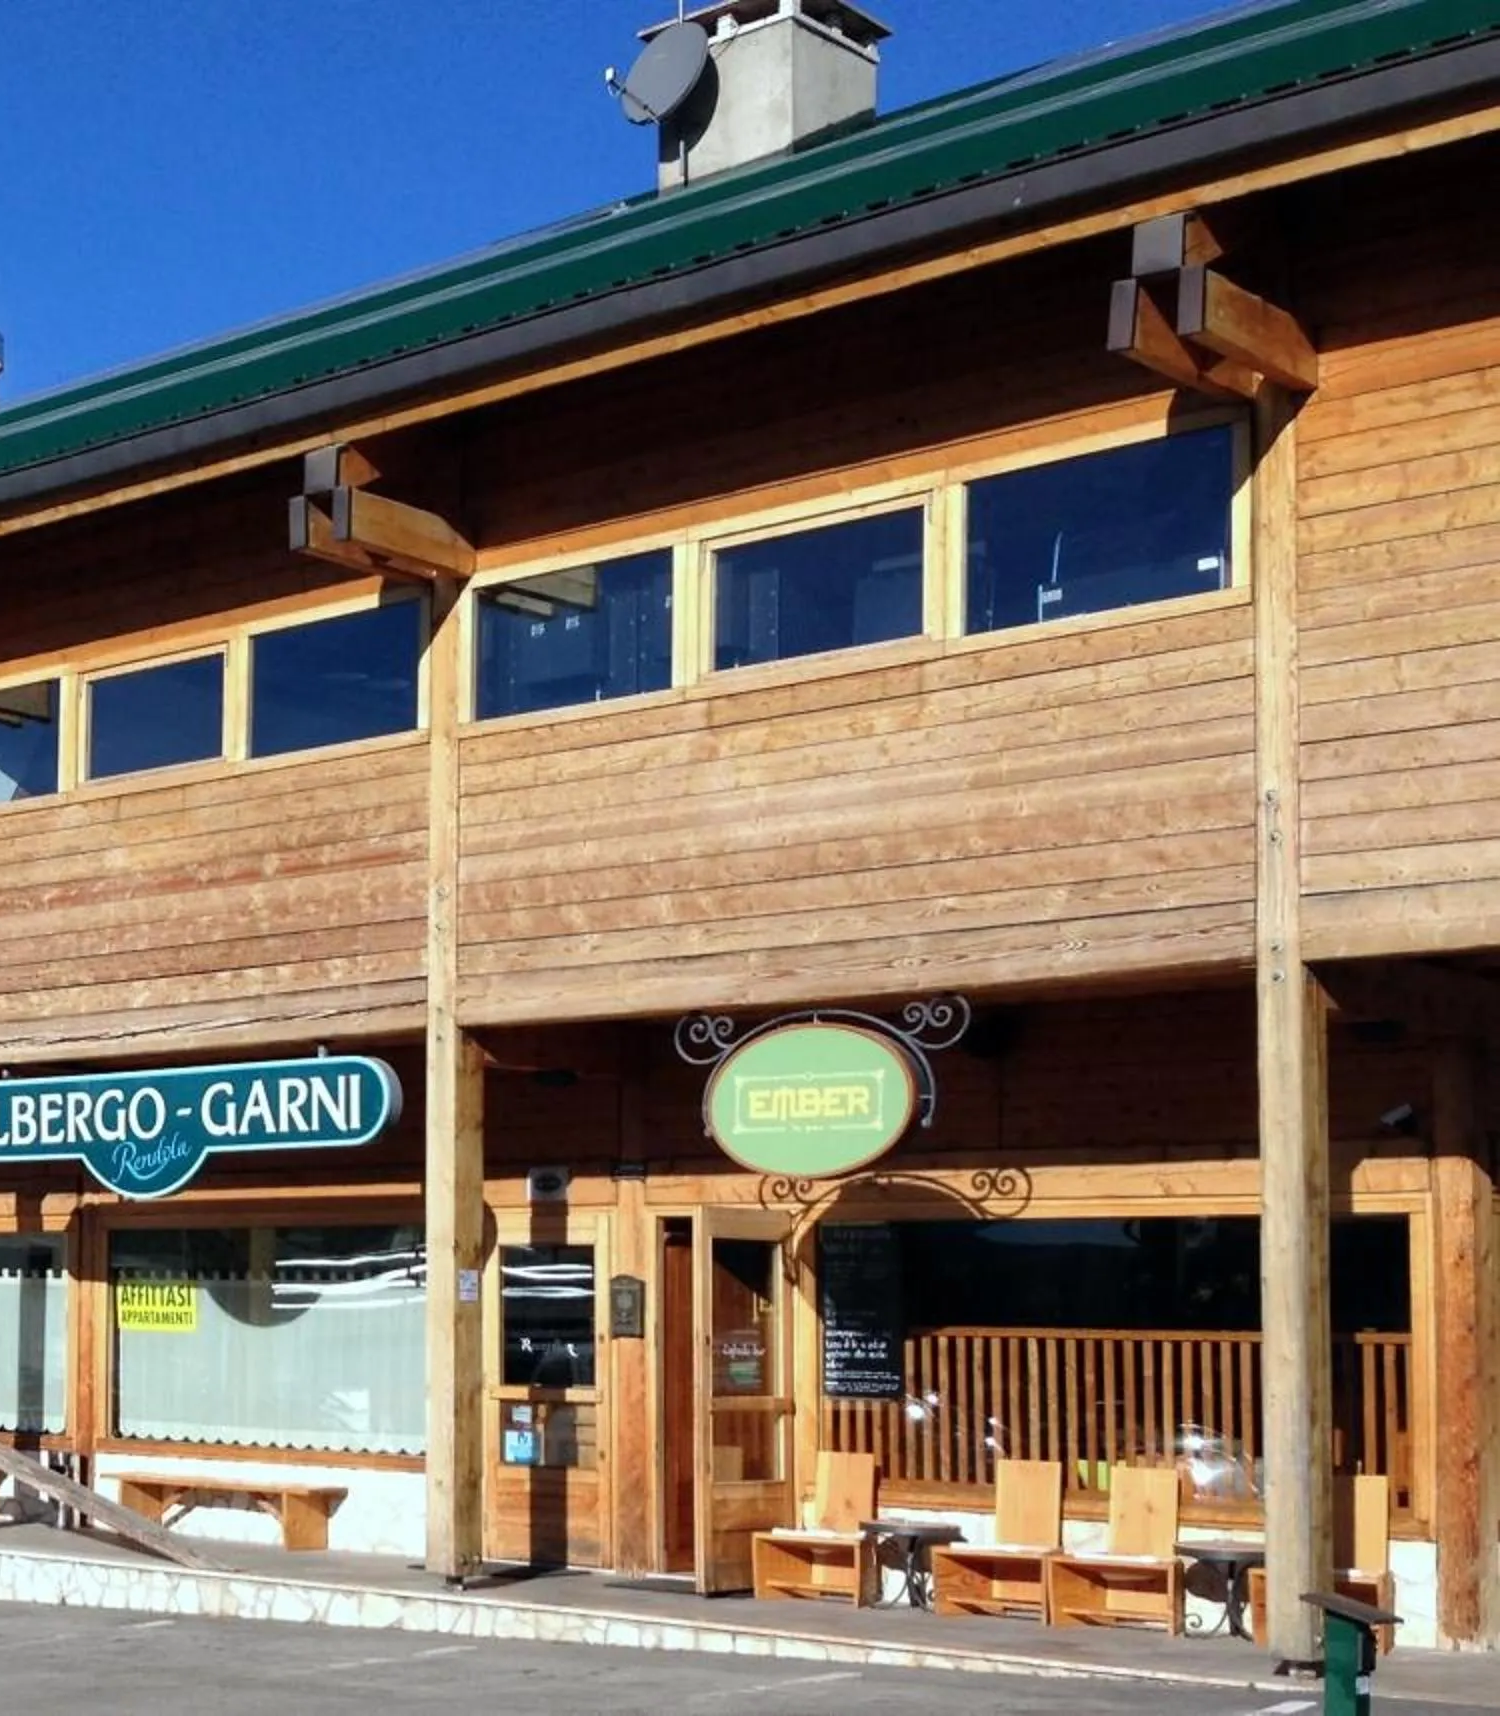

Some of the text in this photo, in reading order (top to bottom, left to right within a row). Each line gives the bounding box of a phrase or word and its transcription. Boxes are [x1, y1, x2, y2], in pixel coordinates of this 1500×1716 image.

[201, 1073, 362, 1137] GARNI
[748, 1086, 870, 1121] EMBER
[110, 1130, 193, 1182] Rendola
[121, 1283, 193, 1307] AFFITTASI
[121, 1310, 194, 1325] APPARTAMENTI
